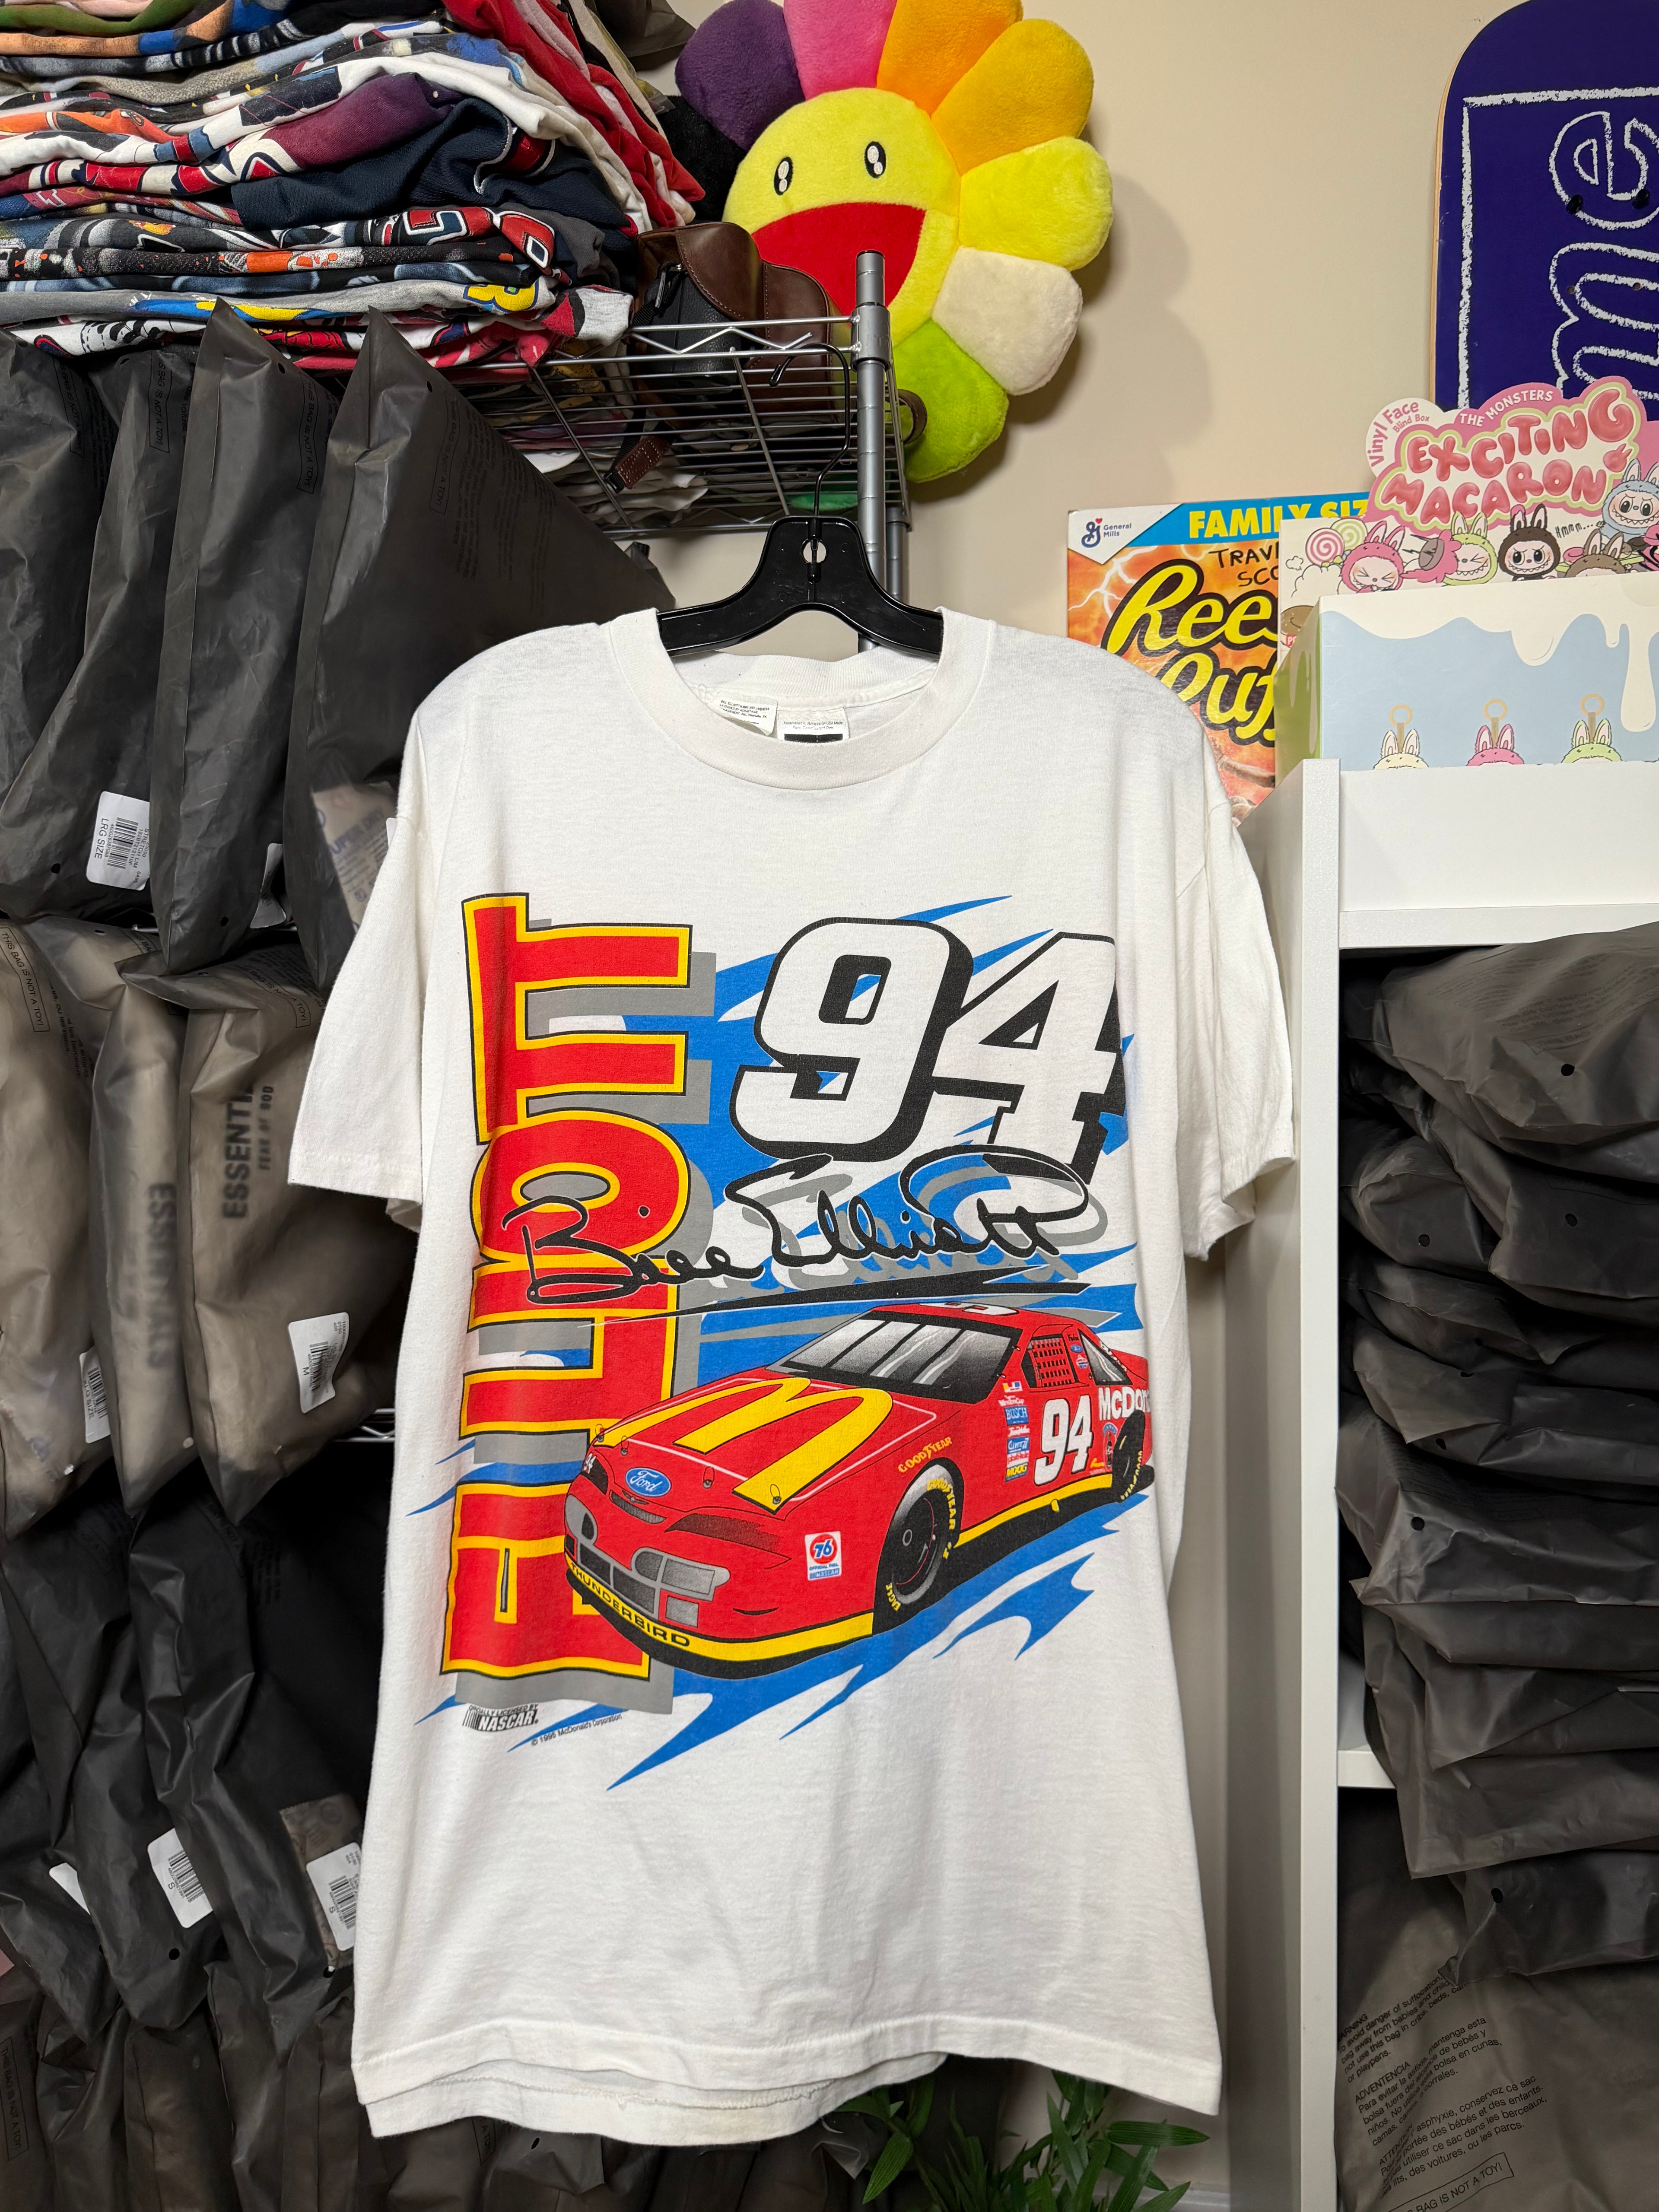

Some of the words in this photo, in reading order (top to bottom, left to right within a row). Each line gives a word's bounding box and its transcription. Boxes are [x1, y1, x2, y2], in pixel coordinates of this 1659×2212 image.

[155, 389, 162, 397] IS
[306, 383, 315, 400] THIS
[306, 403, 314, 422] BAG
[1459, 413, 1484, 427] THE
[1487, 390, 1554, 421] MONSTERS
[304, 425, 311, 433] IS
[448, 423, 457, 442] BAG
[1367, 422, 1387, 467] Vinyl
[1382, 401, 1420, 424] Face
[1392, 415, 1413, 433] Blind
[1414, 414, 1430, 423] Box
[303, 435, 312, 453] NOT
[1407, 388, 1634, 481] EXCITING
[445, 444, 451, 452] IS
[441, 454, 450, 474] NOT
[304, 466, 314, 486] TOY!
[435, 486, 445, 505] TOY!
[1382, 459, 1607, 524] MACARON
[1103, 523, 1132, 531] General
[1103, 530, 1120, 538] Mills
[1106, 564, 1278, 655] Ree
[99, 817, 109, 837] LRG
[94, 839, 105, 859] SIZE
[1, 932, 15, 950] THIS
[10, 950, 25, 968] BAG
[21, 968, 30, 976] IS
[25, 977, 36, 997] NOT
[265, 981, 275, 989] IS
[33, 1007, 44, 1026] TOY!
[55, 1004, 62, 1014] ou
[729, 916, 1125, 1184] 94
[223, 1081, 254, 1220] ESSENTI
[302, 1367, 310, 1375] M
[1005, 1406, 1028, 1421] BUSCH
[1098, 1386, 1150, 1421] McDon
[1034, 1395, 1094, 1487] 94
[898, 1437, 953, 1473] GOODYEAR
[629, 1470, 664, 1492] Ford
[1006, 1463, 1028, 1478] MOOG
[926, 1477, 957, 1531] GOODYEAR
[813, 1538, 833, 1559] 76
[816, 1568, 840, 1578] NASCAR
[570, 1562, 690, 1647] THUNDERBIRD
[530, 1703, 539, 1711] BY
[476, 1709, 537, 1732] NASCAR
[539, 1733, 557, 1743] 1995
[558, 1722, 591, 1736] McDonald's
[592, 1713, 623, 1728] Corporation
[167, 1881, 176, 1890] S
[1345, 2027, 1365, 2048] avoid
[1364, 2009, 1393, 2032] danger
[1392, 2003, 1402, 2013] of
[1372, 2021, 1392, 2037] from
[1391, 2005, 1419, 2025] babies
[1417, 1993, 1433, 2008] and
[1342, 2059, 1356, 2074] not
[1356, 2050, 1370, 2064] use
[1369, 2037, 1384, 2052] this
[1384, 2028, 1401, 2044] bag
[1400, 2022, 1409, 2032] in
[1347, 2073, 1357, 2083] or
[1354, 2047, 1392, 2078] playpens.
[1357, 2096, 1377, 2113] Para
[1376, 2082, 1399, 2101] evitar
[1398, 2075, 1407, 2085] la
[1426, 2025, 1467, 2055] mantenga
[1465, 2016, 1486, 2031] esta
[1353, 2060, 1410, 2103] ADVENTENCIA
[1362, 2105, 1385, 2124] bolsa
[1383, 2091, 1405, 2109] fuera
[1437, 2044, 1451, 2056] de
[1450, 2031, 1480, 2050] bebés
[1479, 2028, 1487, 2037] y
[1366, 2115, 1390, 2135] niños.
[1389, 2105, 1403, 2118] No
[1432, 2053, 1457, 2071] bolsa
[1457, 2049, 1471, 2059] en
[1470, 2036, 1502, 2054] cunas,
[8, 2101, 18, 2118] NOT
[1370, 2123, 1398, 2147] camas,
[1422, 2065, 1458, 2093] corrales.
[1414, 2107, 1458, 2133] asphyxie,
[1458, 2085, 1504, 2113] conservez
[1505, 2084, 1519, 2092] ce
[1519, 2075, 1537, 2088] sac
[1429, 2124, 1448, 2139] des
[1447, 2111, 1478, 2131] bébés
[1478, 2107, 1487, 2117] et
[1487, 2098, 1507, 2111] des
[1508, 2084, 1545, 2107] enfants.
[1401, 2146, 1431, 2168] utiliser
[1432, 2142, 1445, 2152] ce
[1446, 2133, 1463, 2147] sac
[1462, 2121, 1487, 2138] dans
[1485, 2112, 1500, 2126] les
[1501, 2094, 1548, 2120] berceaux,
[1407, 2162, 1427, 2178] des
[1427, 2146, 1467, 2170] voitures,
[1466, 2139, 1480, 2150] ou
[1478, 2129, 1494, 2143] les
[1493, 2120, 1526, 2136] parcs.
[1438, 2192, 1450, 2205] IS
[1449, 2179, 1471, 2199] NOT
[1470, 2175, 1480, 2186] A
[1479, 2161, 1503, 2180] TOY!
